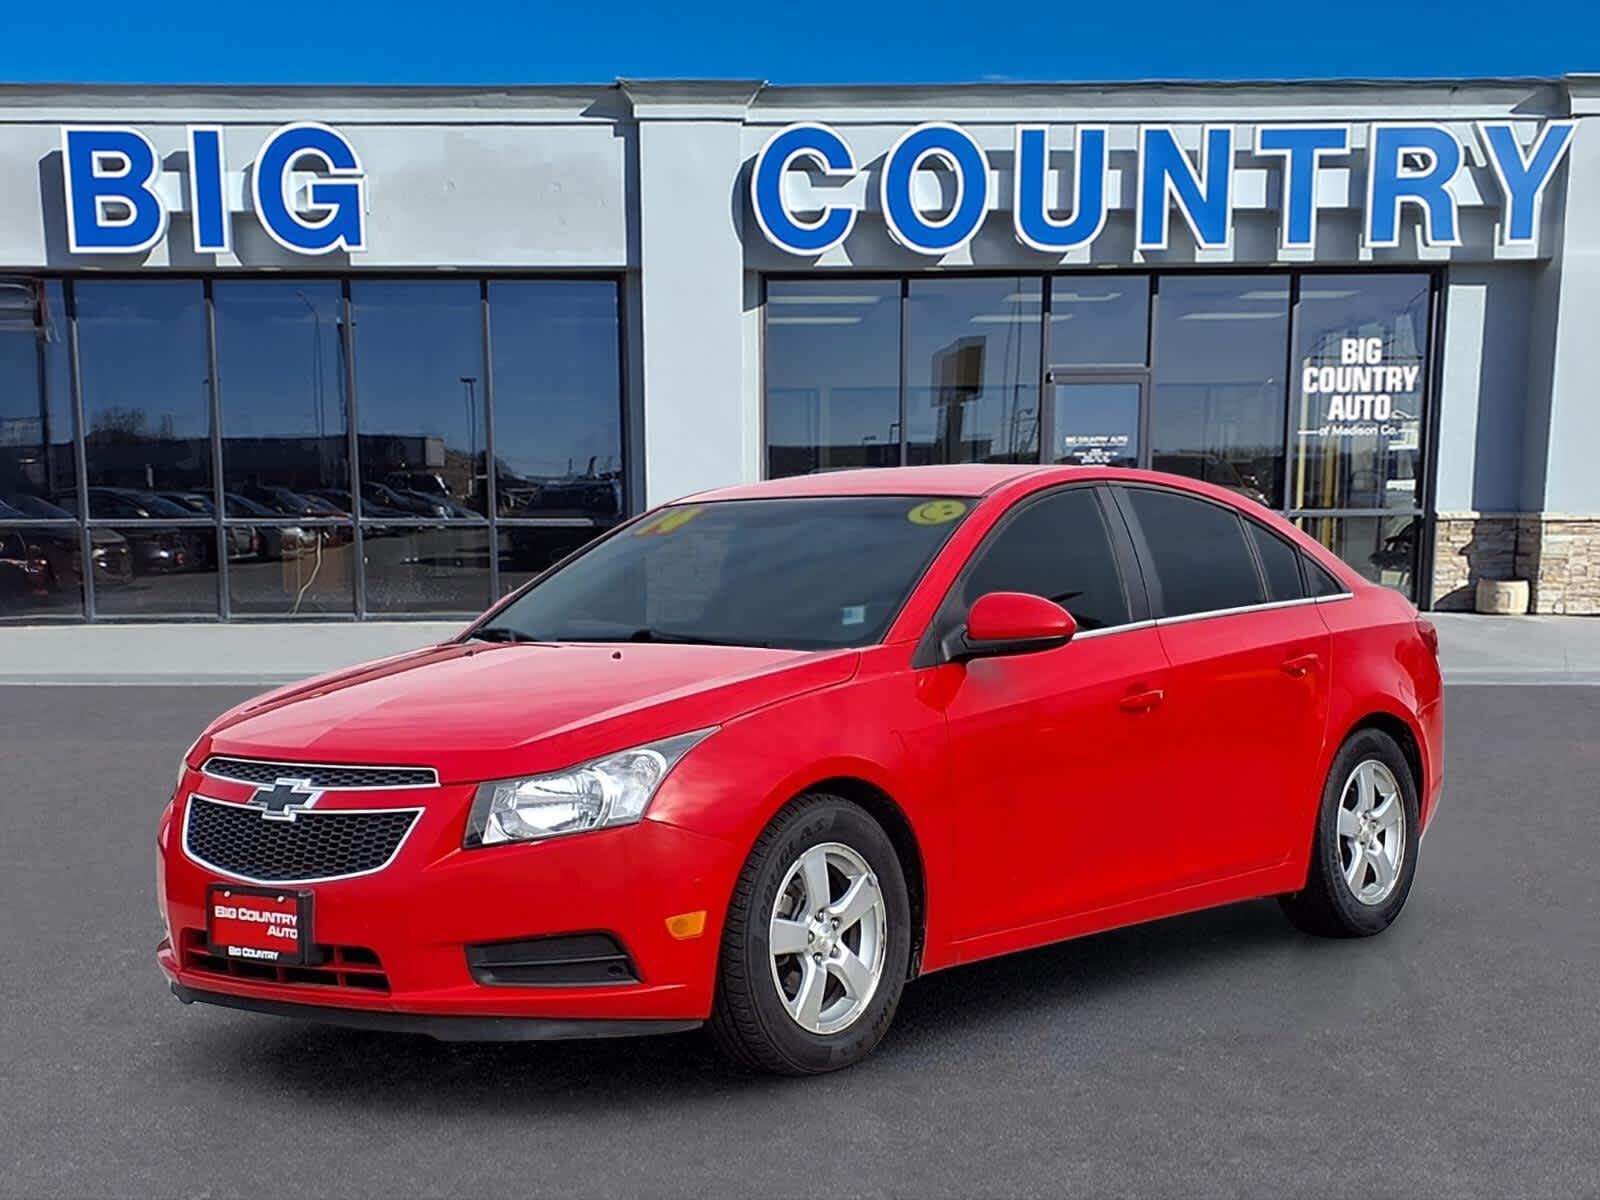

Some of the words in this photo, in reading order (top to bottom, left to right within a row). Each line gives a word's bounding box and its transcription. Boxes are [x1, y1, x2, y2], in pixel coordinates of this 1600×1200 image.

[61, 122, 367, 254] BIG
[750, 120, 1577, 255] COUNTRY
[1341, 337, 1382, 364] BIG
[1303, 366, 1419, 393] COUNTRY
[1327, 394, 1391, 421] AUTO
[1331, 424, 1378, 436] Madison
[214, 905, 237, 919] BIG
[238, 907, 298, 926] COUNTRY
[266, 925, 298, 940] AUTO
[242, 947, 279, 960] COUNTRY
